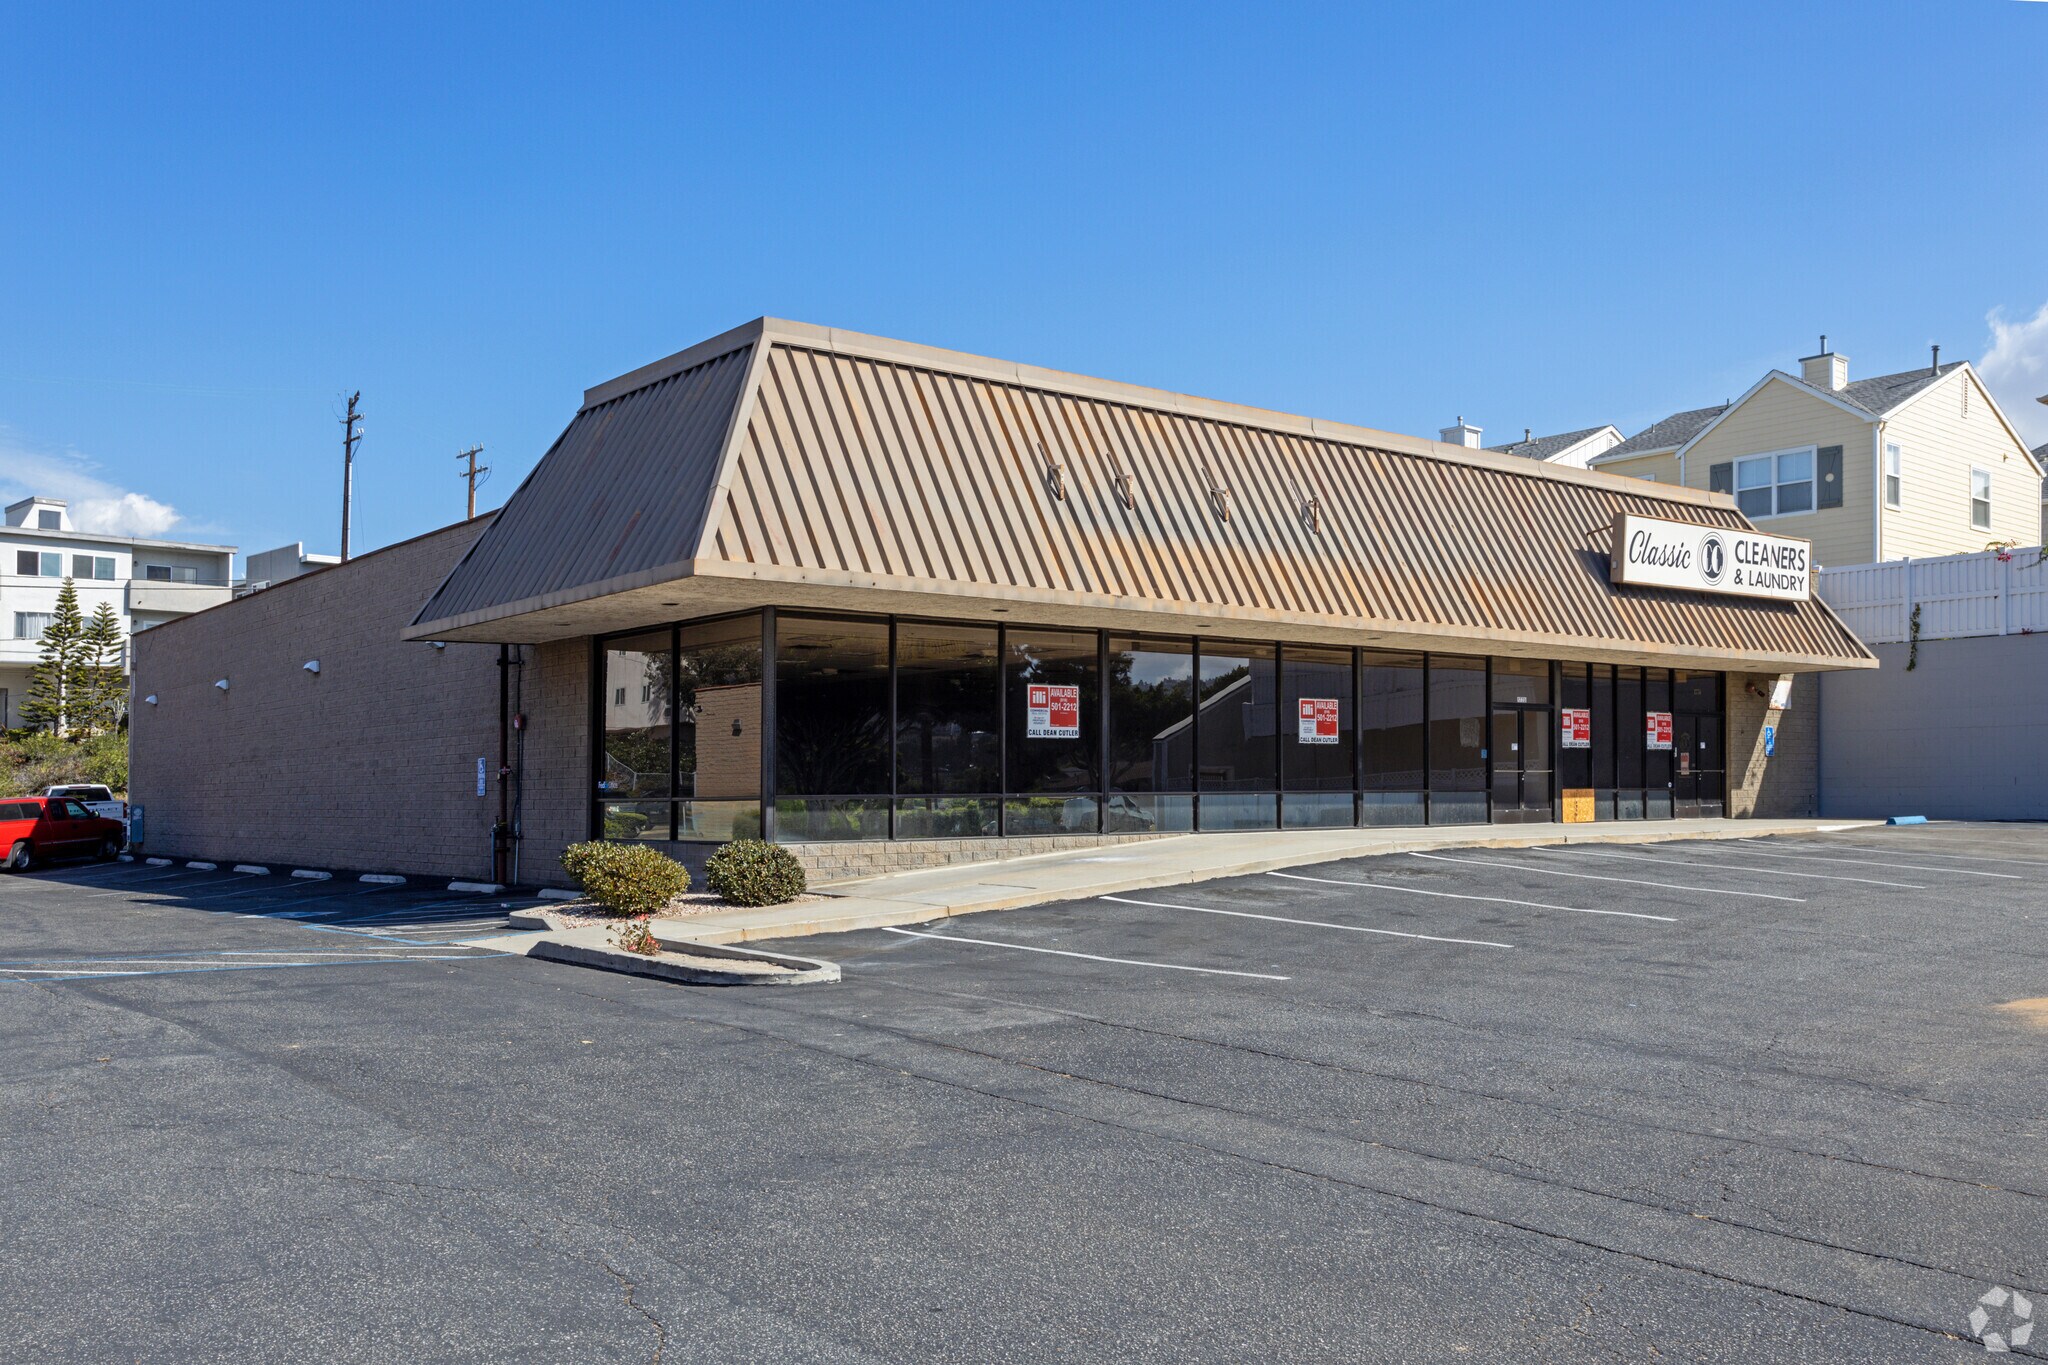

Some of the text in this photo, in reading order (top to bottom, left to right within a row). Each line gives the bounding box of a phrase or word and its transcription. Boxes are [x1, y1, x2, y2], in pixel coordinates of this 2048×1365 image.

[1629, 530, 1691, 570] Classic
[1735, 540, 1806, 572] CLEANERS
[1734, 568, 1806, 592] & LAUNDRY
[1050, 688, 1077, 698] AVAILABLE
[1051, 702, 1077, 712] 501-2212
[1316, 701, 1337, 710] AVAILABLE
[1058, 729, 1079, 737] CUTLER
